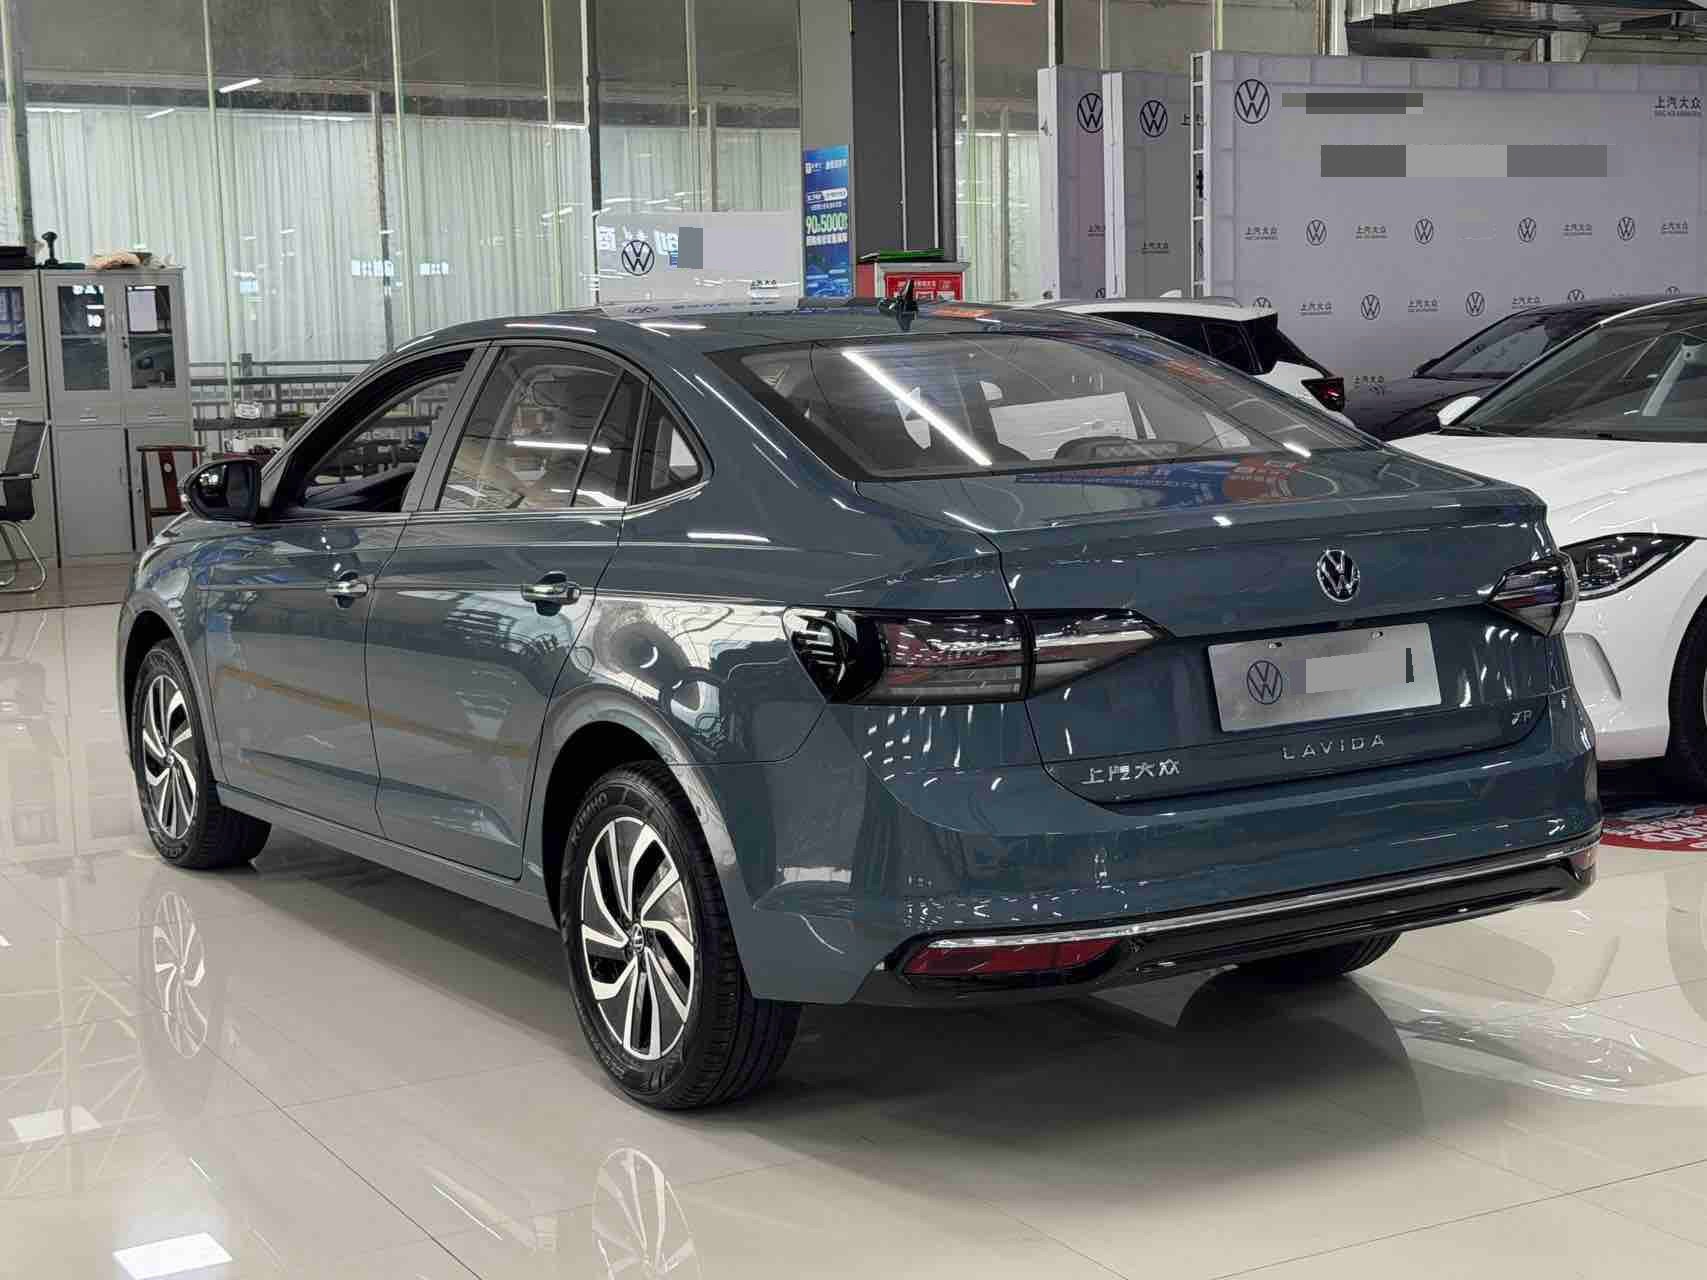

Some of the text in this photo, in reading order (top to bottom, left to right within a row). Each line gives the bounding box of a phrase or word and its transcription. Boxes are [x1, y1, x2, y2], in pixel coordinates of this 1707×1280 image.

[1655, 95, 1702, 110] 上汽大众
[1283, 735, 1384, 760] LAVIDA
[1080, 758, 1181, 784] 上汽大众
